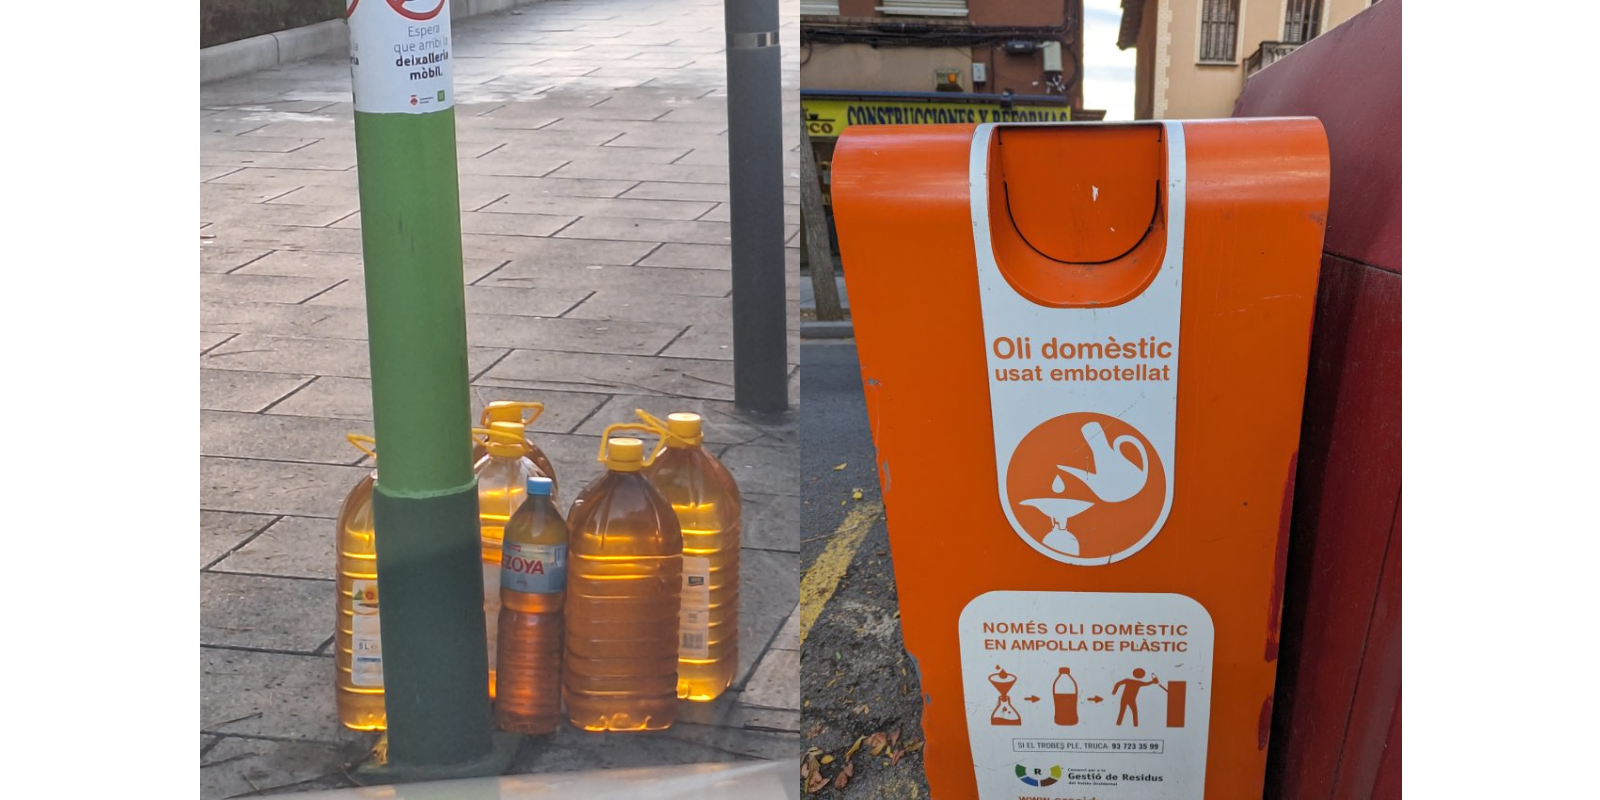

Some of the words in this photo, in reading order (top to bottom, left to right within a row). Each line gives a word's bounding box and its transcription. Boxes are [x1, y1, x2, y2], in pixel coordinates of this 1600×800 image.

[408, 24, 440, 39] Espera
[393, 42, 416, 56] que
[395, 49, 449, 67] deixalleria
[846, 106, 976, 126] CONSTRUCCIONES
[978, 109, 988, 124] Y
[806, 122, 834, 134] CO
[993, 336, 1032, 360] Oli
[1041, 336, 1173, 360] domèstic
[995, 365, 1043, 382] usat
[1049, 364, 1171, 382] embotellat
[502, 553, 544, 575] ZOYA
[983, 620, 1048, 635] NOMÉS
[1055, 623, 1084, 635] OLI
[1091, 622, 1189, 636] DOMÈSTIC
[984, 639, 1006, 650] EN
[1010, 640, 1089, 652] AMPOLLA
[1092, 641, 1115, 652] DE
[1119, 638, 1189, 653] PLÀSTIC
[1034, 768, 1042, 776] R
[1068, 772, 1102, 781] Gestió
[1105, 773, 1118, 781] de
[1122, 774, 1164, 782] Residus
